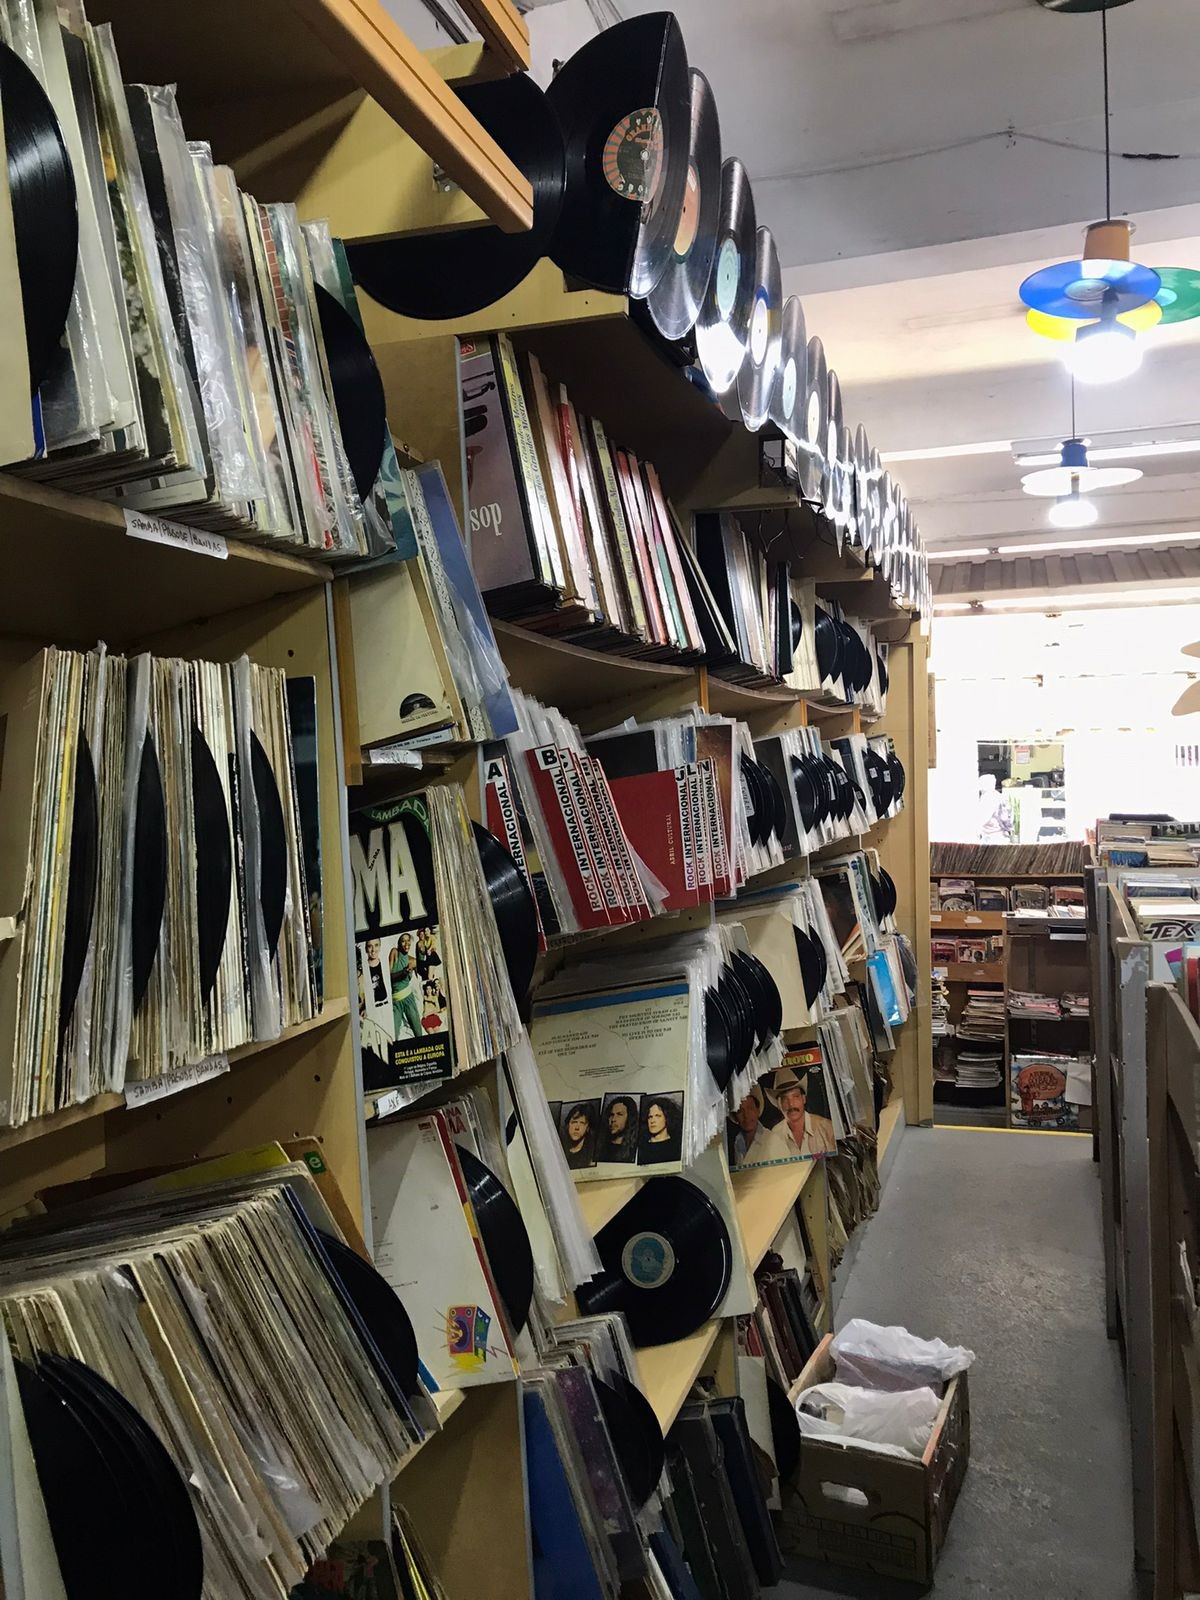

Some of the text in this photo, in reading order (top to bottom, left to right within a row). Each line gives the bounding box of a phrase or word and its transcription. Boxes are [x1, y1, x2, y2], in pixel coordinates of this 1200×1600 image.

[516, 394, 529, 431] Mestres
[524, 432, 539, 472] Grandes
[487, 762, 503, 780] A
[541, 749, 558, 766] B
[690, 778, 704, 854] INTERNACIONAL
[705, 774, 720, 848] INTERNACIONAL
[554, 769, 601, 910] ROCK INTERNACIONAL
[570, 772, 618, 906] ROCK INTERNACIONAL
[679, 782, 695, 889] ROCK INTERNACIONAL
[698, 856, 707, 884] ROCK
[713, 850, 723, 877] ROCK
[1149, 919, 1196, 940] TEX
[413, 1046, 435, 1055] LAMBADA
[309, 1156, 322, 1168] e
